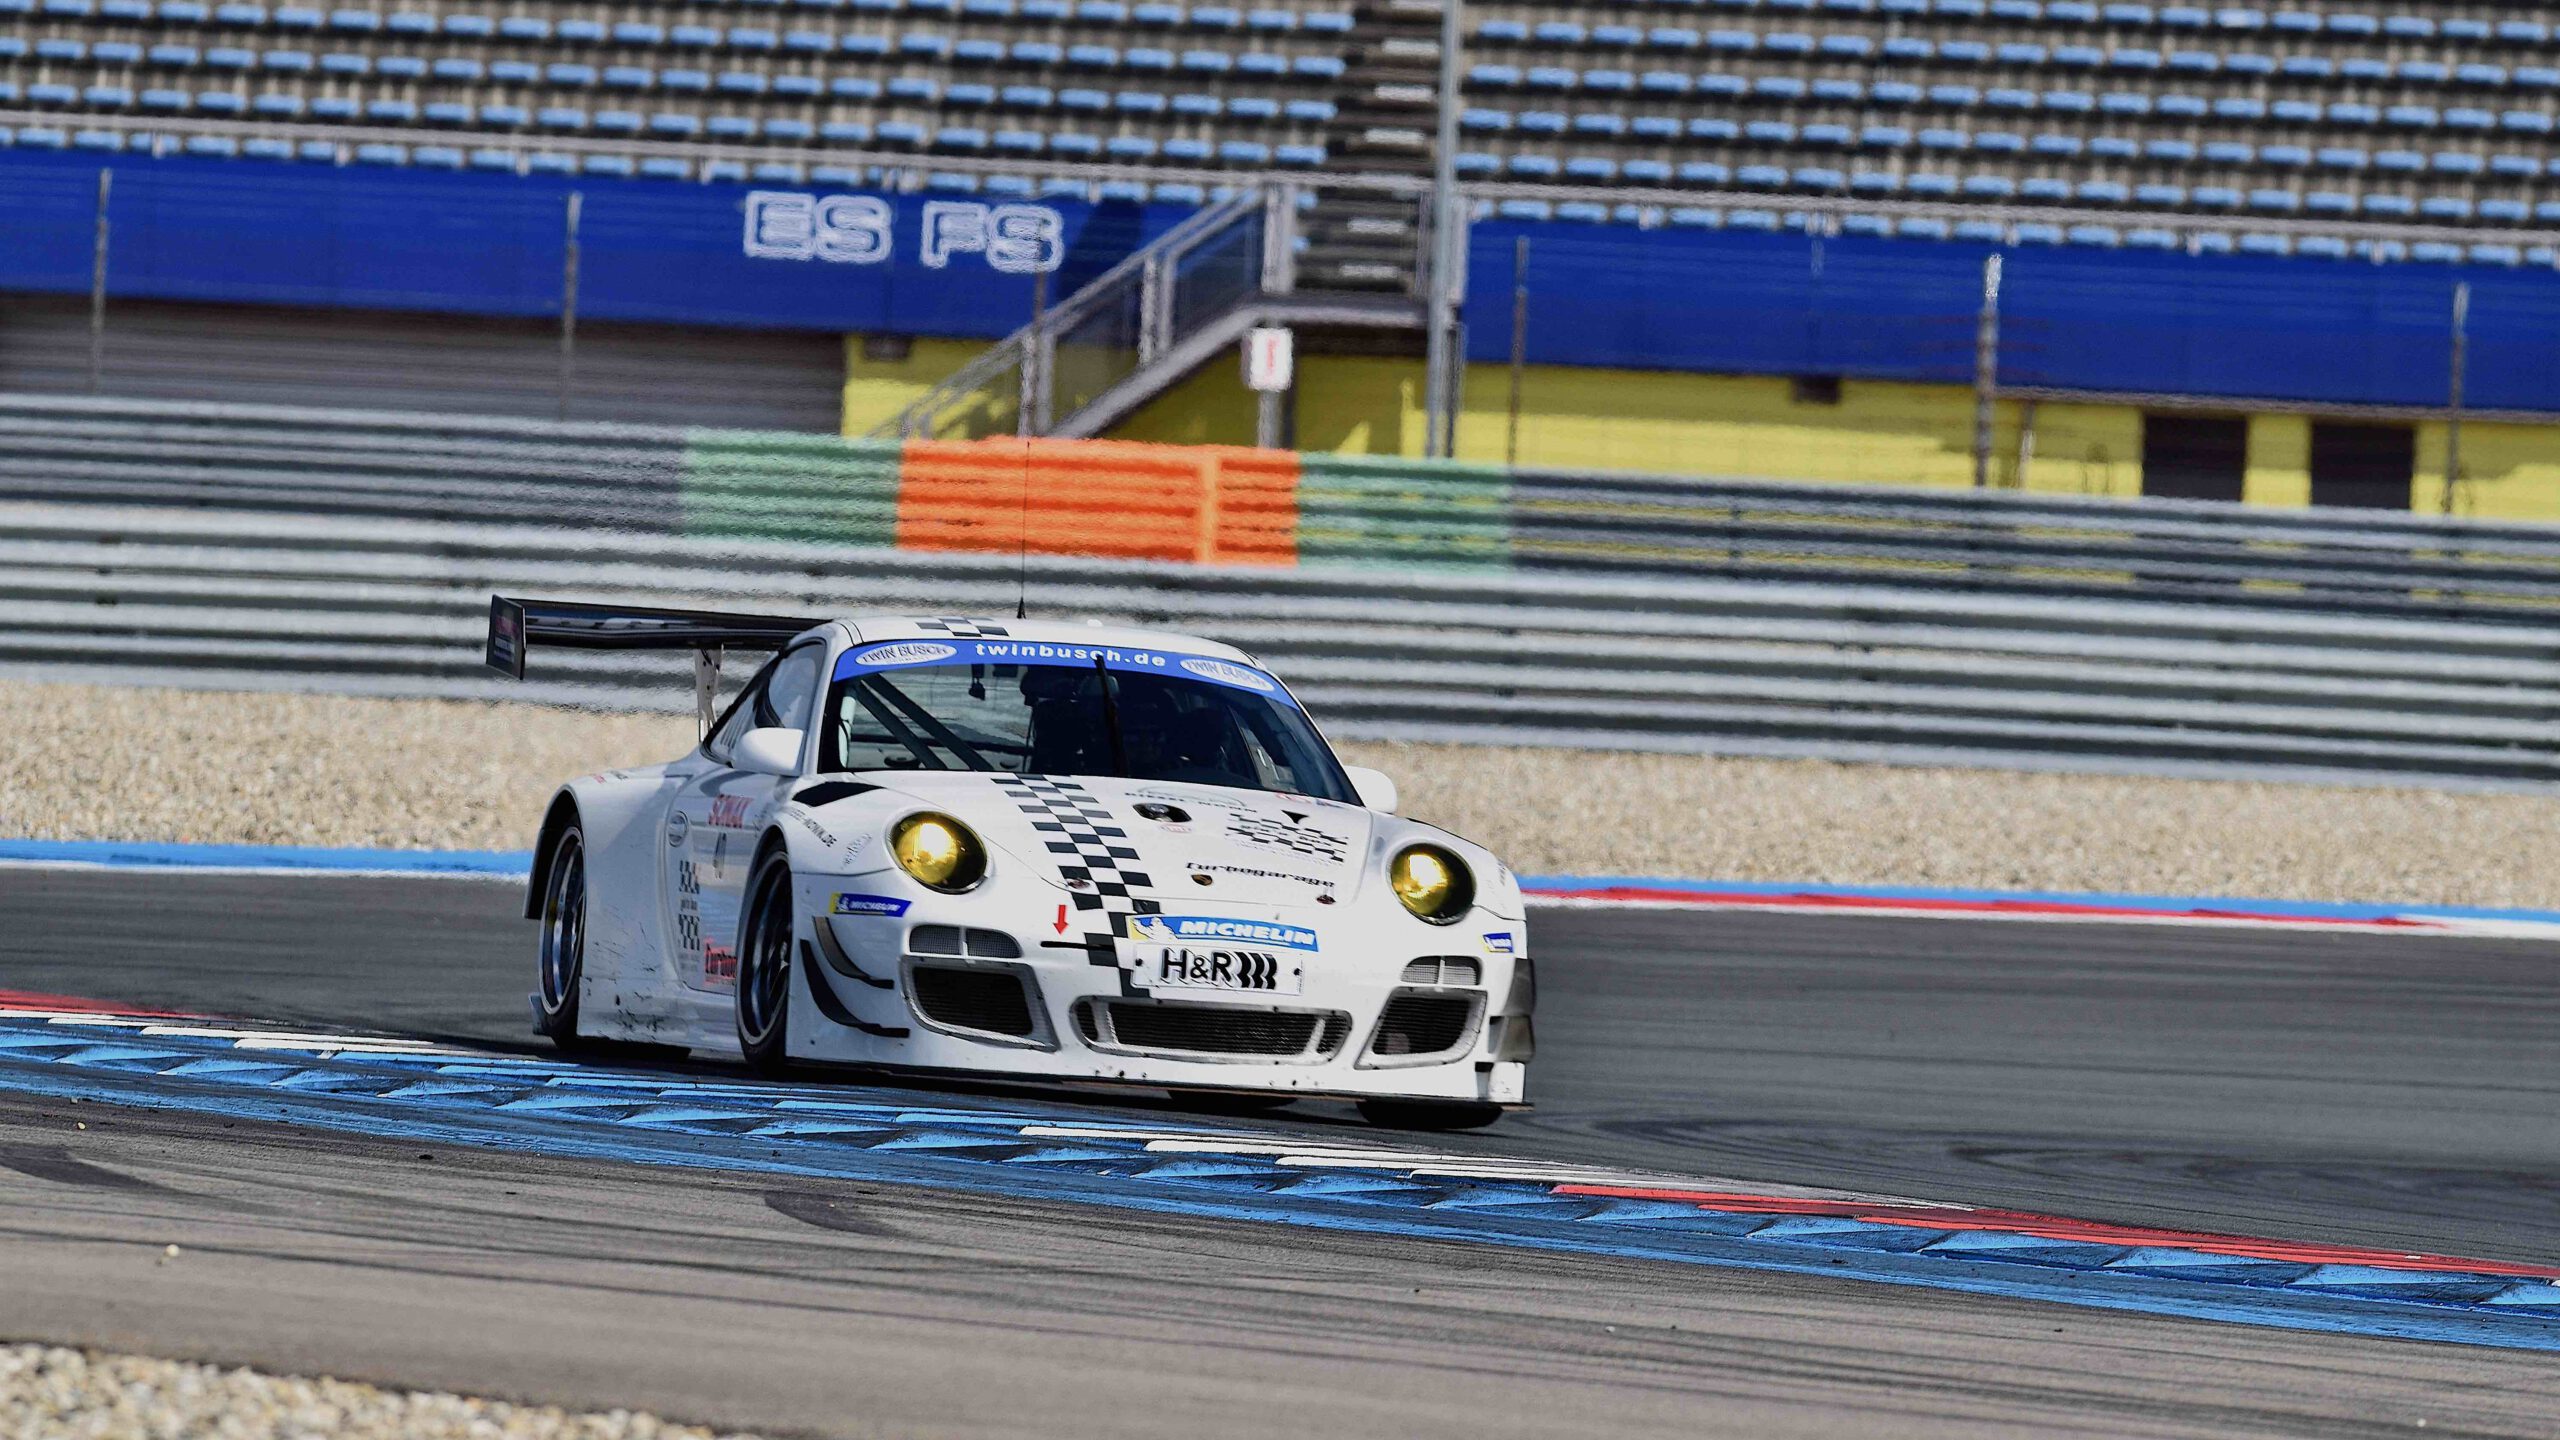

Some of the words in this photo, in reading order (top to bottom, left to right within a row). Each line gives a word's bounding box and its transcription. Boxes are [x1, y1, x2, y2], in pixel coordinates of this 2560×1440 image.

[743, 190, 892, 264] ES
[899, 645, 947, 658] BUSCH
[976, 643, 1166, 667] twinbusch.de
[1179, 919, 1316, 946] MICHELIN
[1160, 948, 1233, 984] H&R
